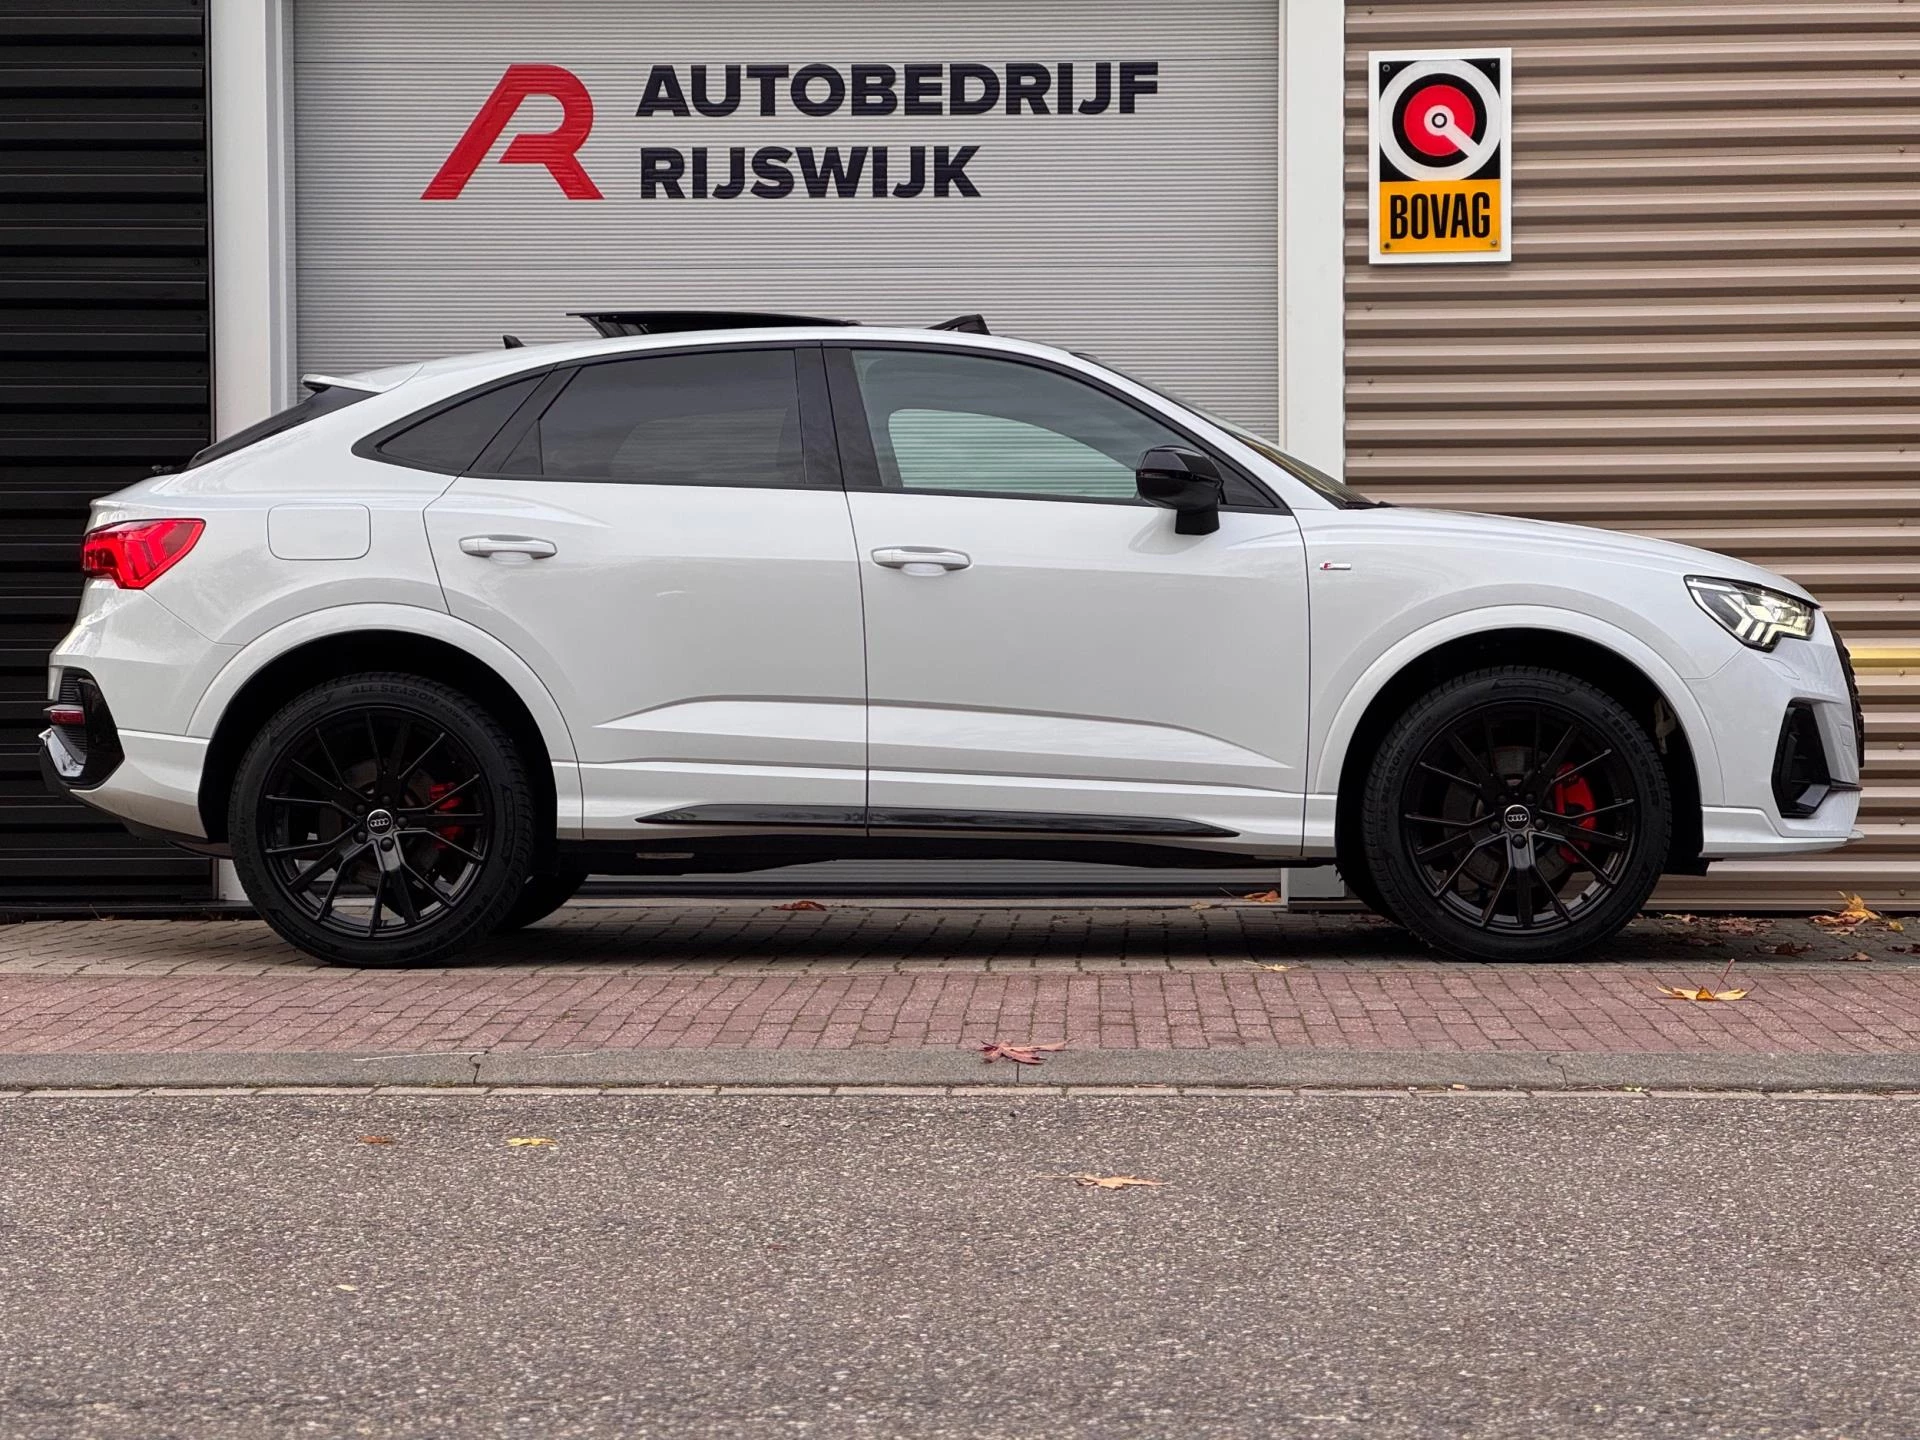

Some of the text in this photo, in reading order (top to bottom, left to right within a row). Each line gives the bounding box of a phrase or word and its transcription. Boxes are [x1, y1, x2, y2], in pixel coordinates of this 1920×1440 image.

[636, 61, 1159, 118] AUTOBEDRIJF
[640, 145, 981, 200] RIJSWIJK
[1390, 191, 1491, 240] BOVAG
